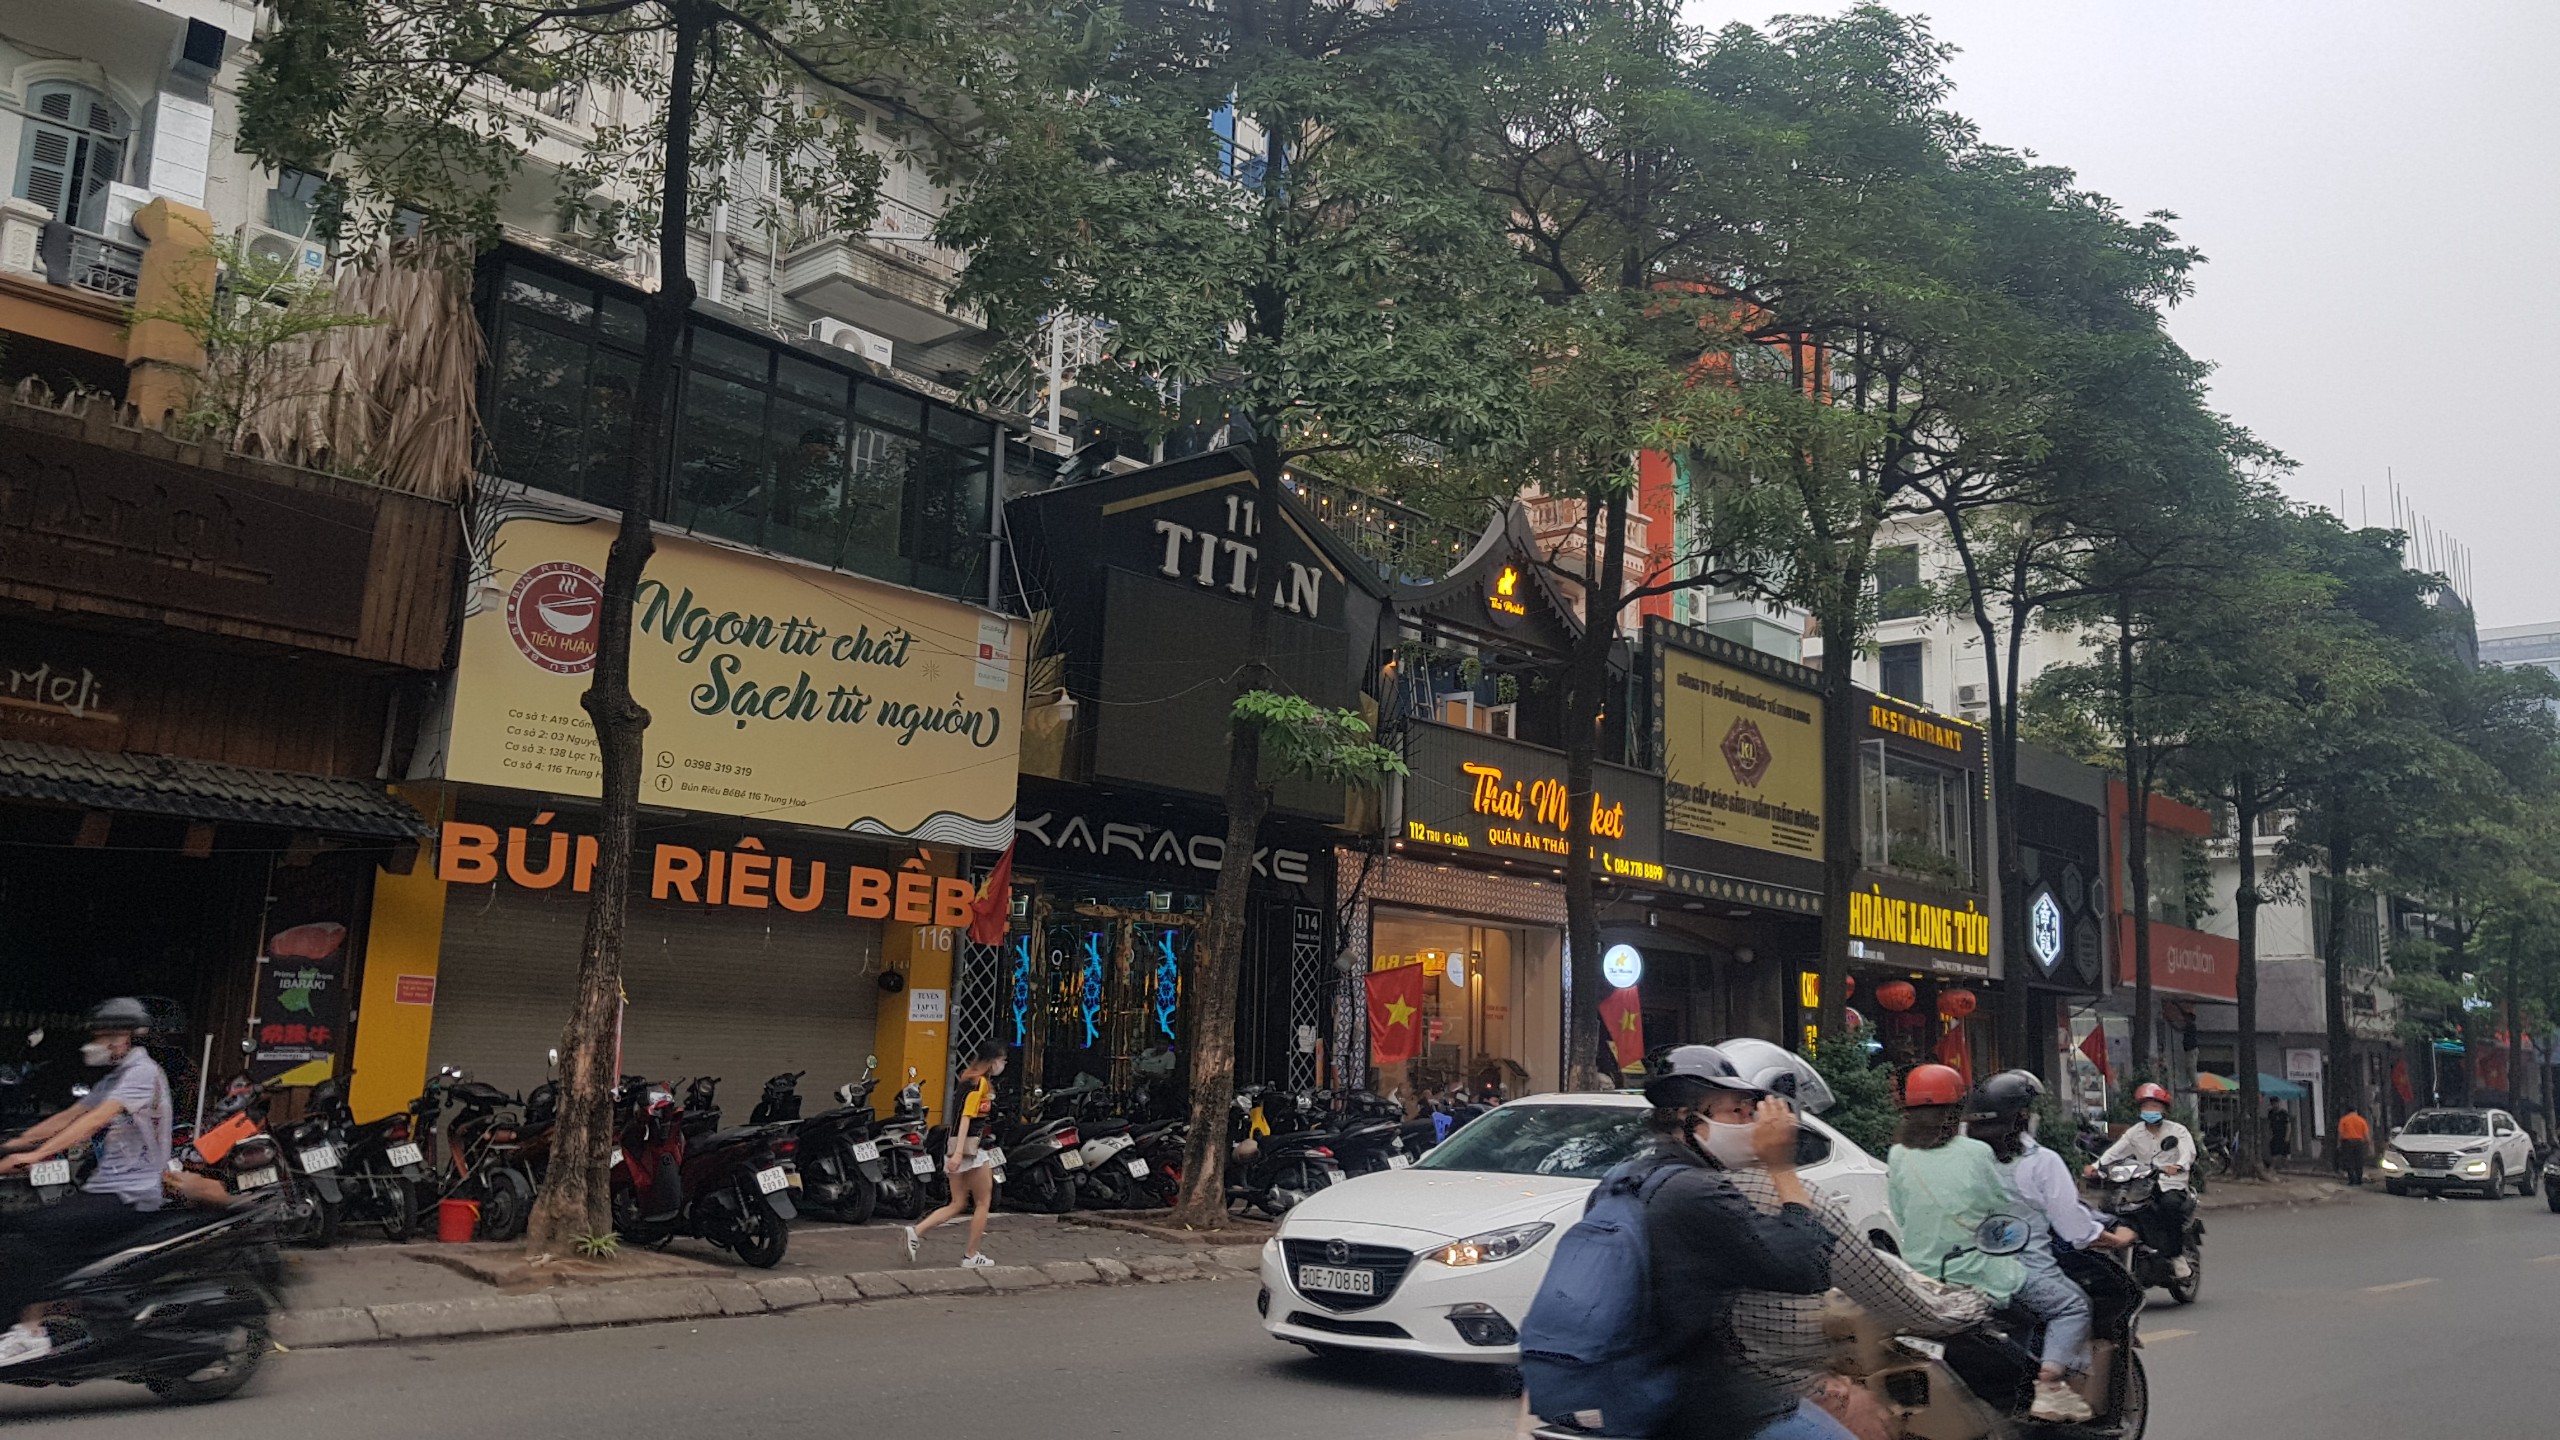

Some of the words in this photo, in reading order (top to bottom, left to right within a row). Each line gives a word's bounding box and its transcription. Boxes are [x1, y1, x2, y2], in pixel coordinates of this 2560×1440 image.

[1226, 494, 1261, 538] 11
[636, 579, 778, 663] Ngon
[780, 615, 827, 655] từ
[831, 624, 920, 668] chất
[690, 654, 822, 730] Sạch
[826, 684, 873, 724] từ
[876, 692, 1000, 748] nguồn
[549, 716, 569, 725] A19
[1869, 705, 1963, 752] RESTAURANT
[538, 730, 548, 739] 2:
[551, 732, 565, 741] 03
[536, 746, 547, 755] 3:
[549, 748, 567, 758] 138
[569, 751, 586, 761] Lạc
[535, 763, 545, 772] 4:
[548, 764, 562, 773] 116
[565, 766, 593, 779] Trung
[684, 758, 712, 771] 0398
[713, 762, 732, 774] 319
[734, 765, 753, 777] 319
[680, 782, 699, 792] Bún
[748, 791, 762, 801] 116
[763, 794, 788, 806] Trung
[1462, 761, 1524, 822] Thai
[1530, 778, 1626, 840] Mket
[1409, 821, 1426, 841] 112
[1426, 829, 1451, 845] TRUG
[1488, 827, 1519, 849] QUÁN
[650, 836, 827, 913] RIÊU
[846, 848, 1012, 933] BỀB
[1297, 913, 1319, 931] 114
[1849, 883, 1907, 945] HOÀNG
[1909, 902, 1952, 951] LONG
[918, 927, 952, 952] 116
[2167, 945, 2215, 974] guardian
[279, 978, 326, 990] IBARAKI
[1301, 1267, 1370, 1292] 30E-708.68
